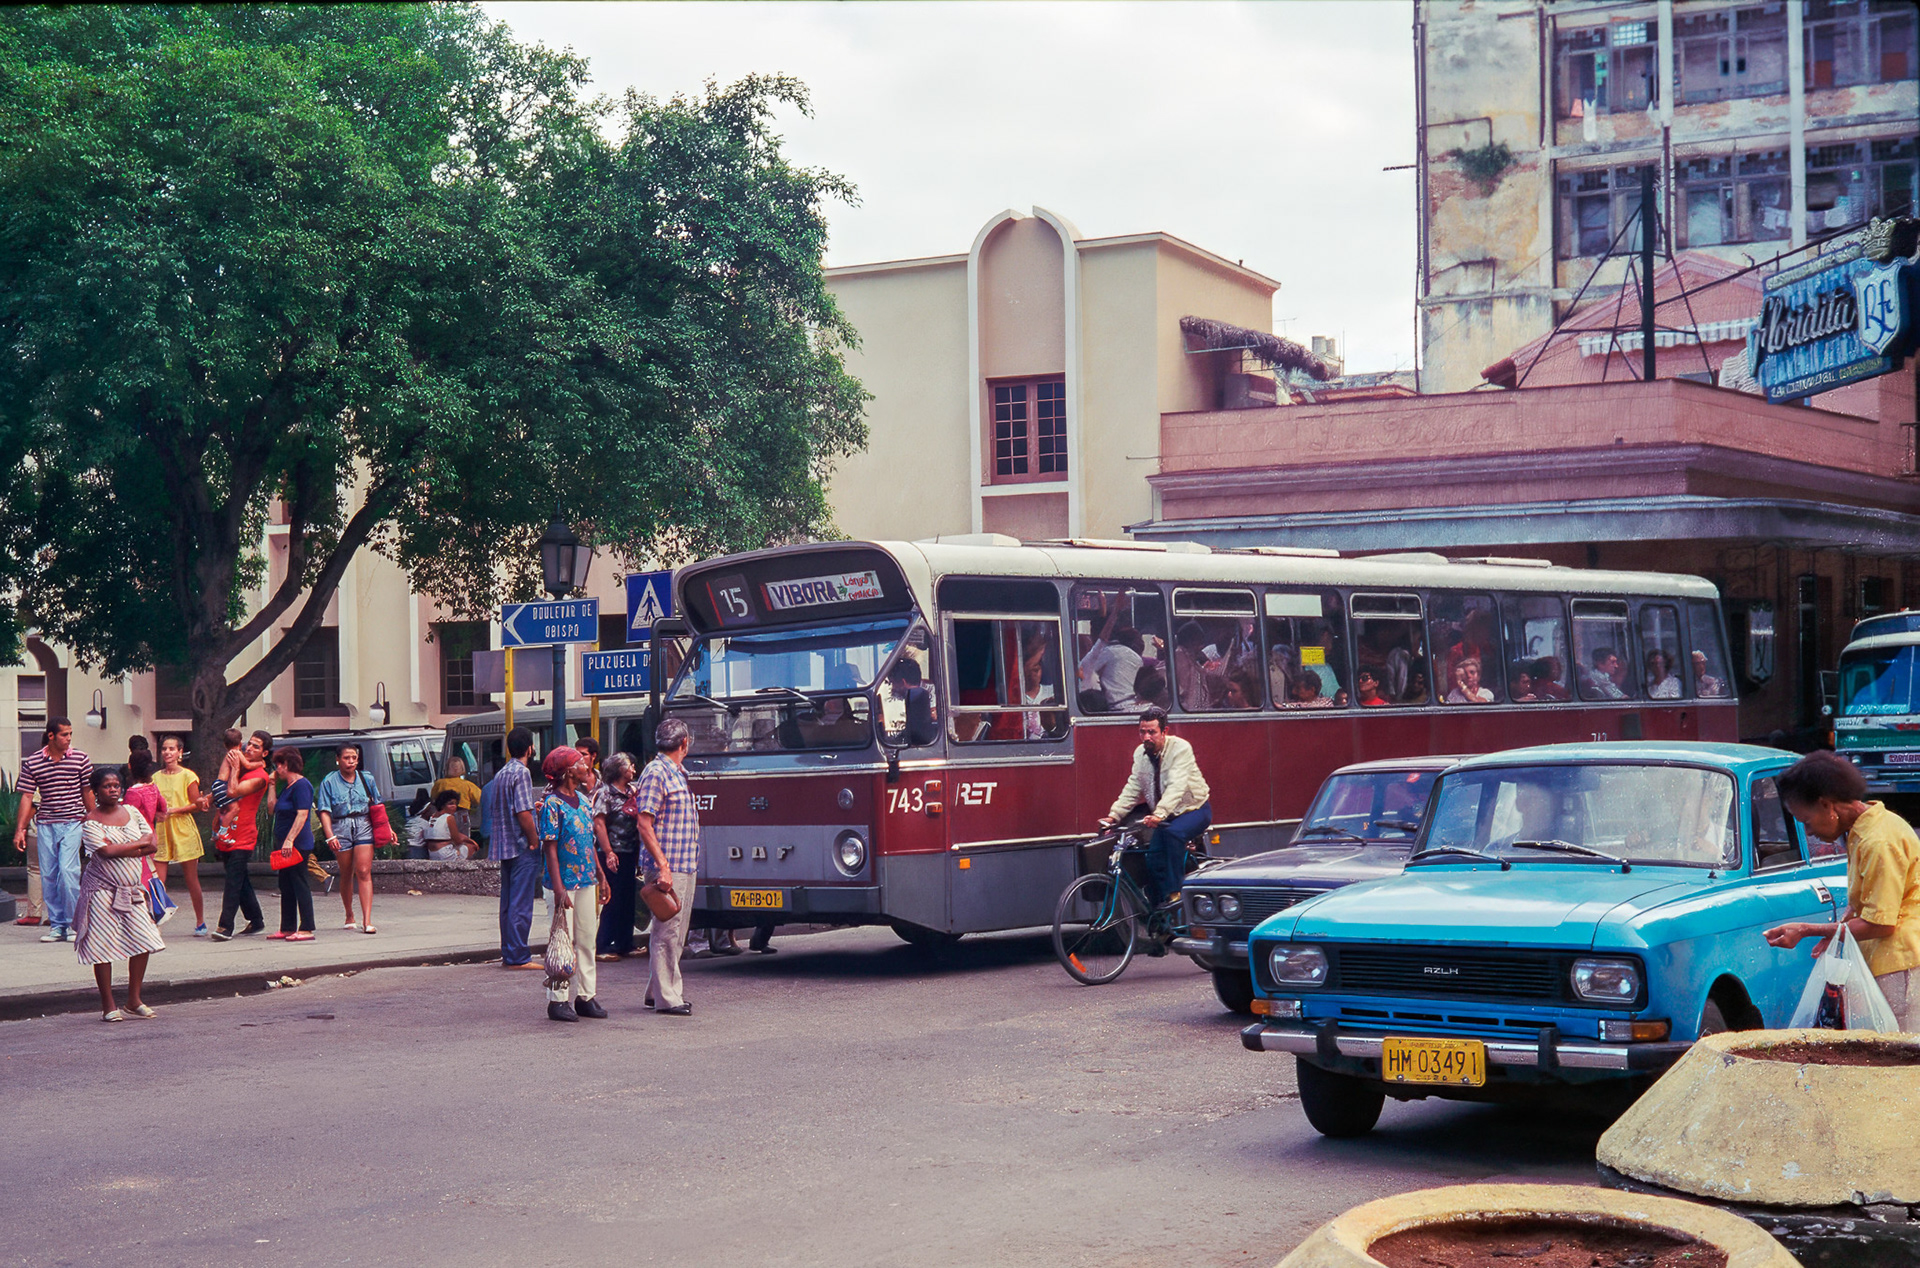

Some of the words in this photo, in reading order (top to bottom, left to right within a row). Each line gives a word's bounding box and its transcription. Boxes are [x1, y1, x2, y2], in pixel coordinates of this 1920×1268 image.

[771, 581, 841, 607] VIBORA
[720, 587, 748, 617] 15
[581, 603, 593, 617] DE
[545, 624, 579, 638] OBISPO
[588, 654, 637, 669] PLAZUELA
[604, 674, 642, 688] ALBEAR
[887, 788, 924, 813] 743
[954, 782, 998, 806] RET
[728, 845, 795, 860] DAF
[1423, 966, 1459, 975] AZLK
[1389, 1049, 1412, 1072] HM
[1418, 1049, 1477, 1075] 03491
